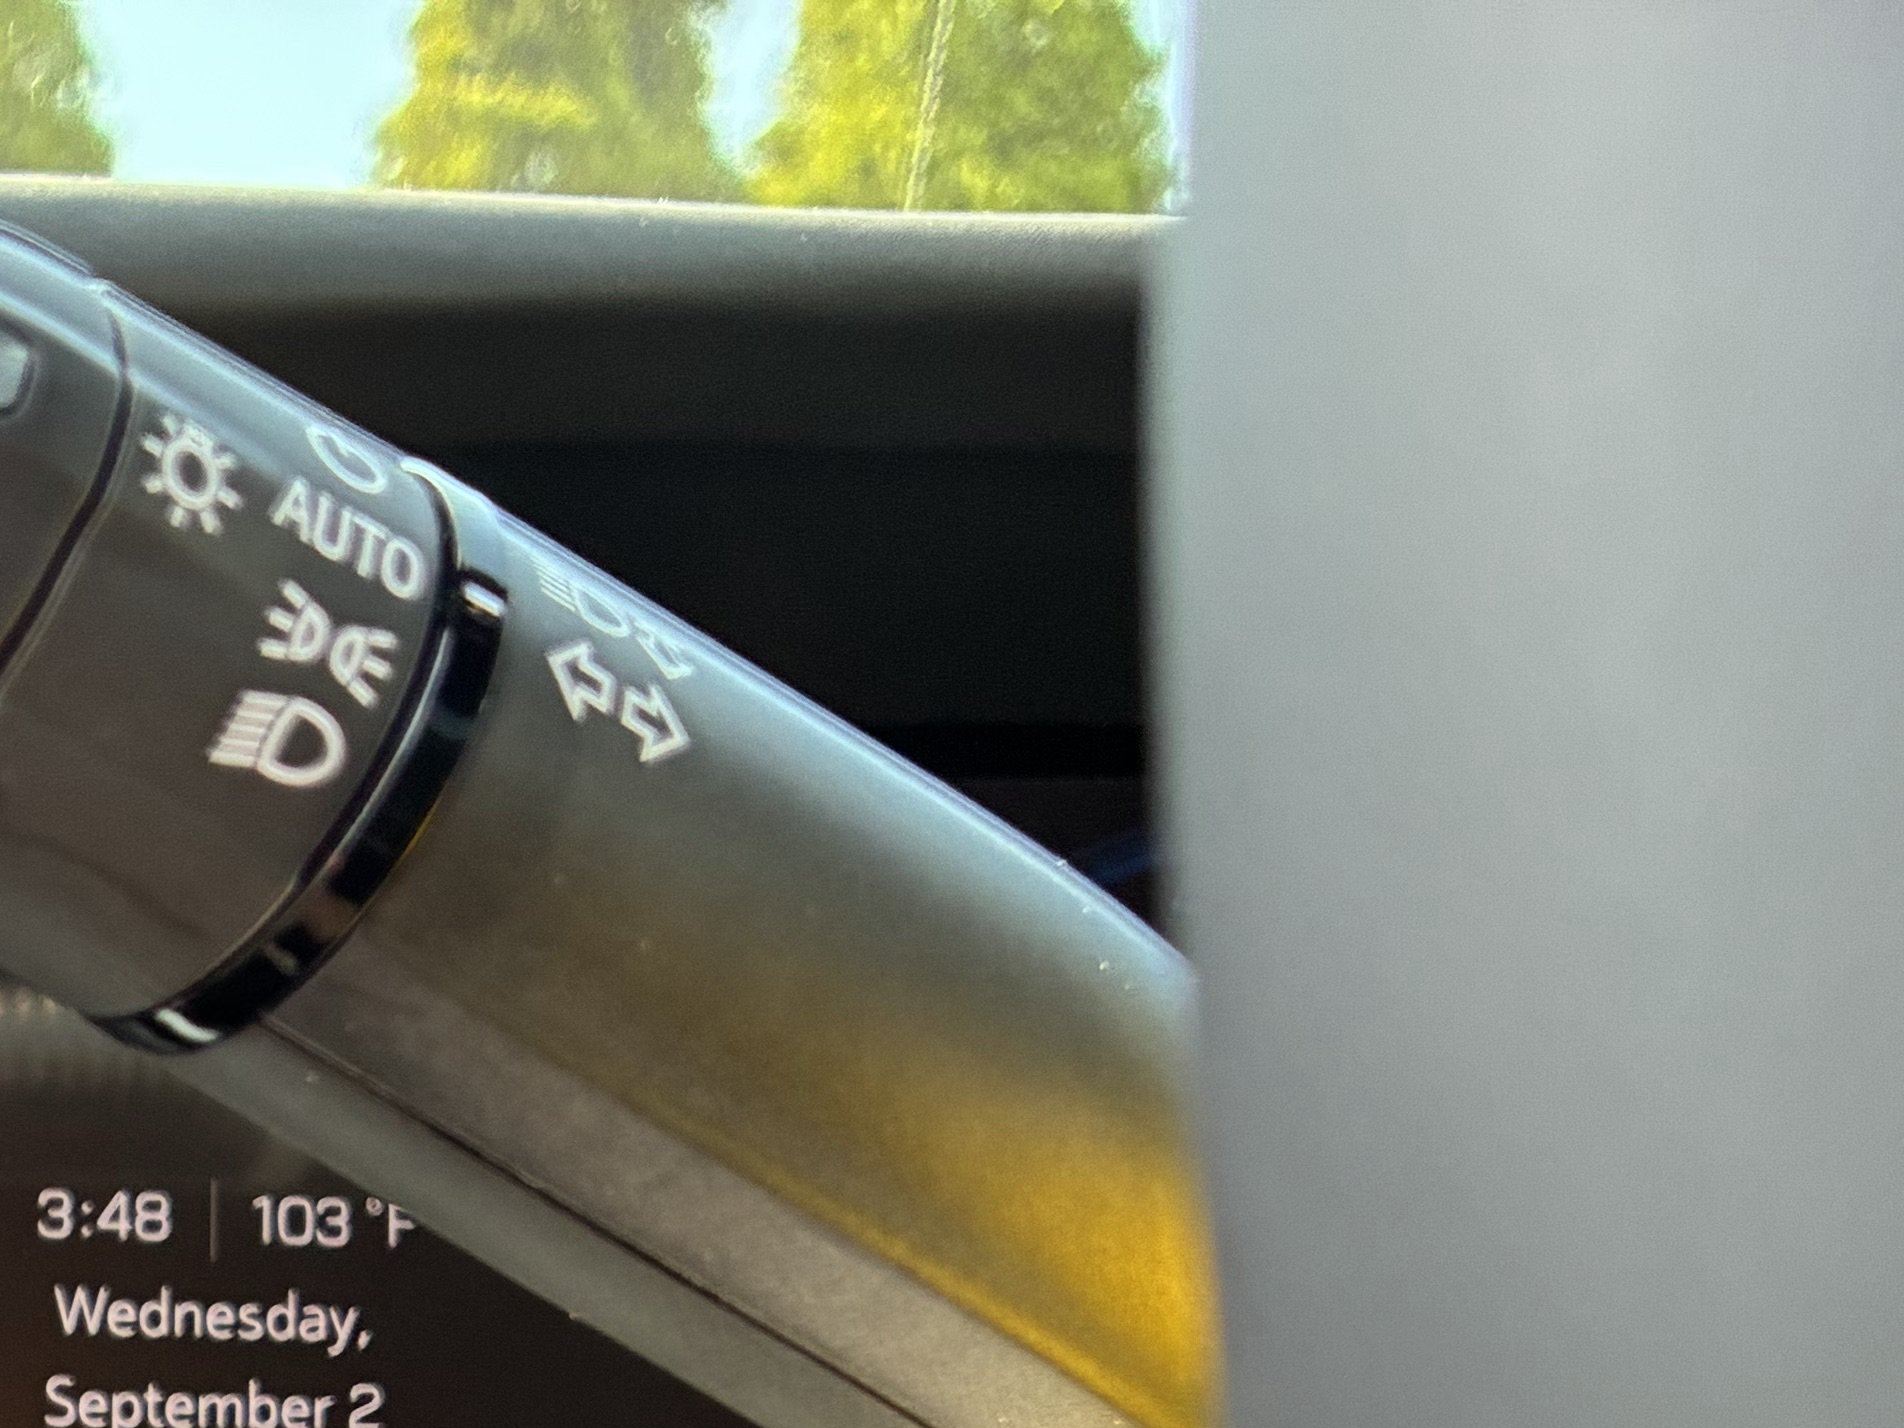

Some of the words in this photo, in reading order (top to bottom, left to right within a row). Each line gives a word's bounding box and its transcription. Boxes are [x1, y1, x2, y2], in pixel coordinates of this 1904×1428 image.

[269, 475, 424, 600] AUTO
[38, 1188, 171, 1243] 3:48
[54, 1284, 371, 1357] Wednesday,
